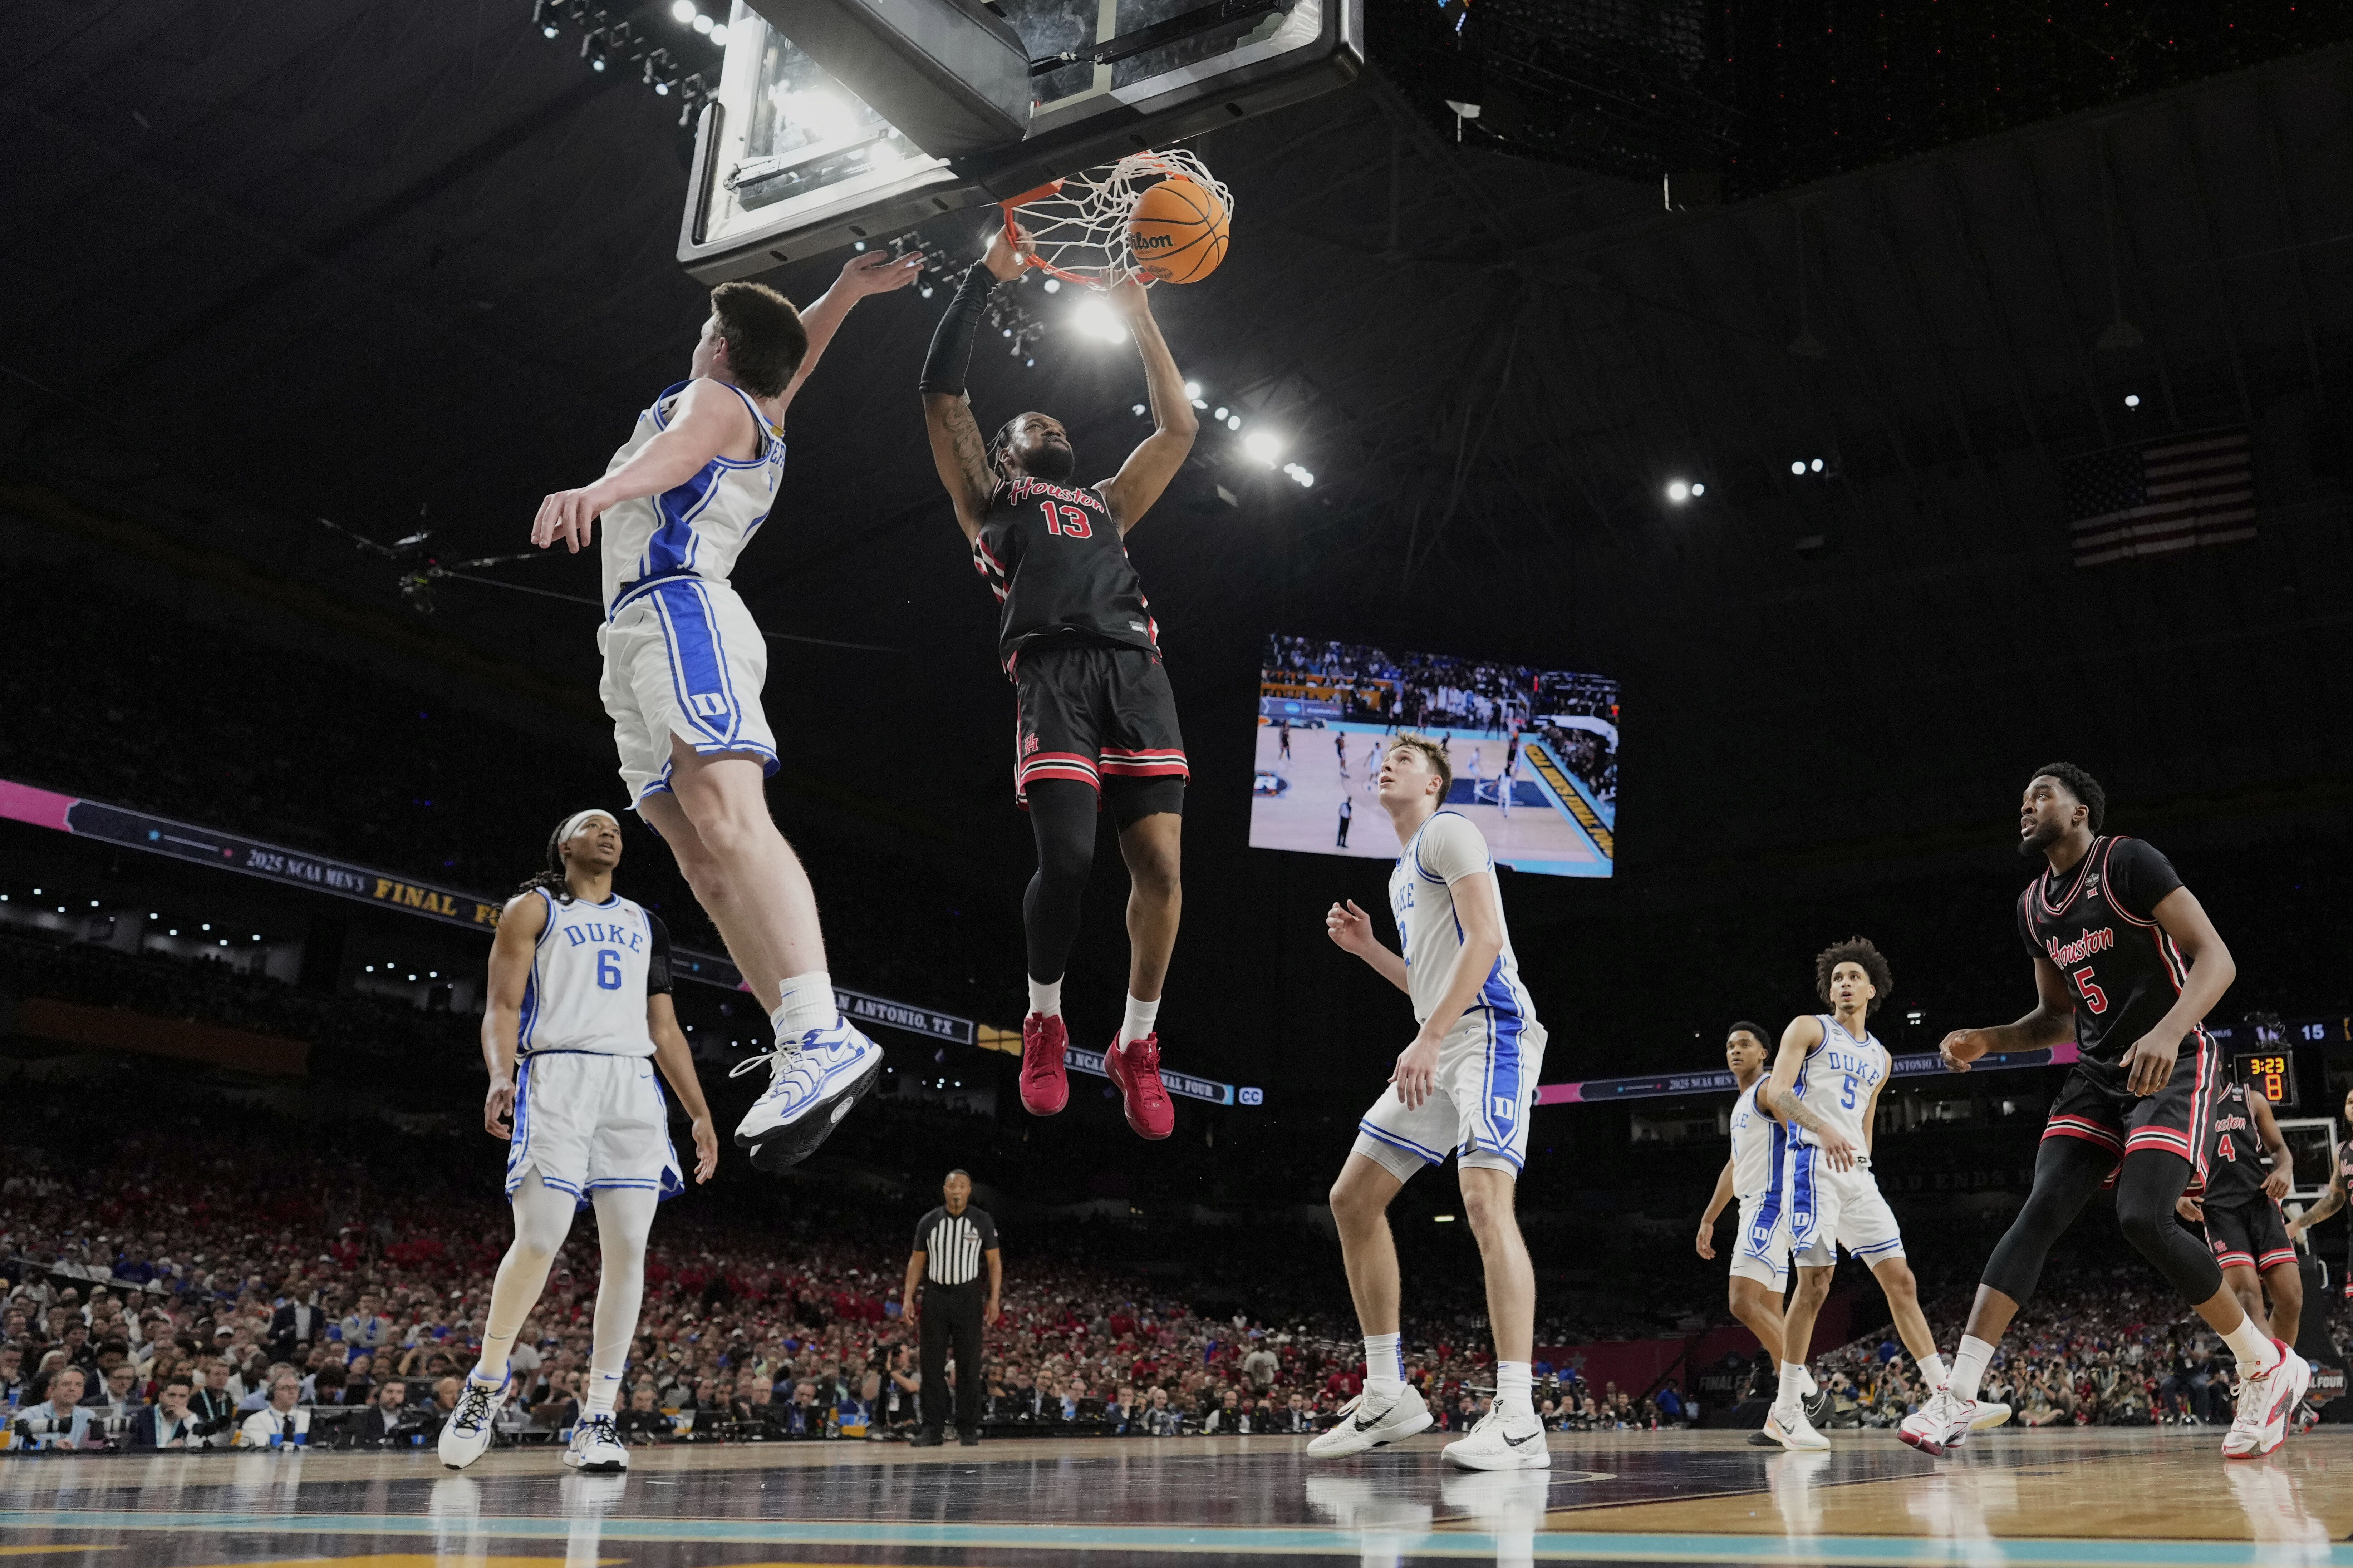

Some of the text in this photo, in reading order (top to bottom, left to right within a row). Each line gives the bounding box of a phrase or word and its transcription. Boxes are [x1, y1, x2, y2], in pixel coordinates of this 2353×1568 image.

[1007, 477, 1105, 514] Houston
[1040, 500, 1093, 539] 13
[246, 849, 283, 873] 2025
[287, 859, 322, 882] NCAA
[324, 868, 366, 893] MEN'S
[373, 877, 457, 916] FINAL
[1394, 883, 1414, 919] UKE
[564, 924, 643, 954] DUKE
[2046, 926, 2113, 970] Houston
[598, 949, 622, 990] 6
[2073, 965, 2108, 1015] 5
[854, 999, 928, 1030] ANTONIO,
[932, 1017, 953, 1036] TX
[2302, 1023, 2325, 1041] 15
[1828, 1052, 1880, 1087] DUKE
[2250, 1056, 2285, 1075] 3:23
[1184, 1078, 1213, 1098] FOUR
[1241, 1090, 1260, 1103] CC
[1841, 1074, 1858, 1110] 5
[2265, 1073, 2283, 1101] 8
[2215, 1113, 2246, 1133] uston
[2218, 1134, 2236, 1162] 4
[2317, 1376, 2344, 1389] FOUR
